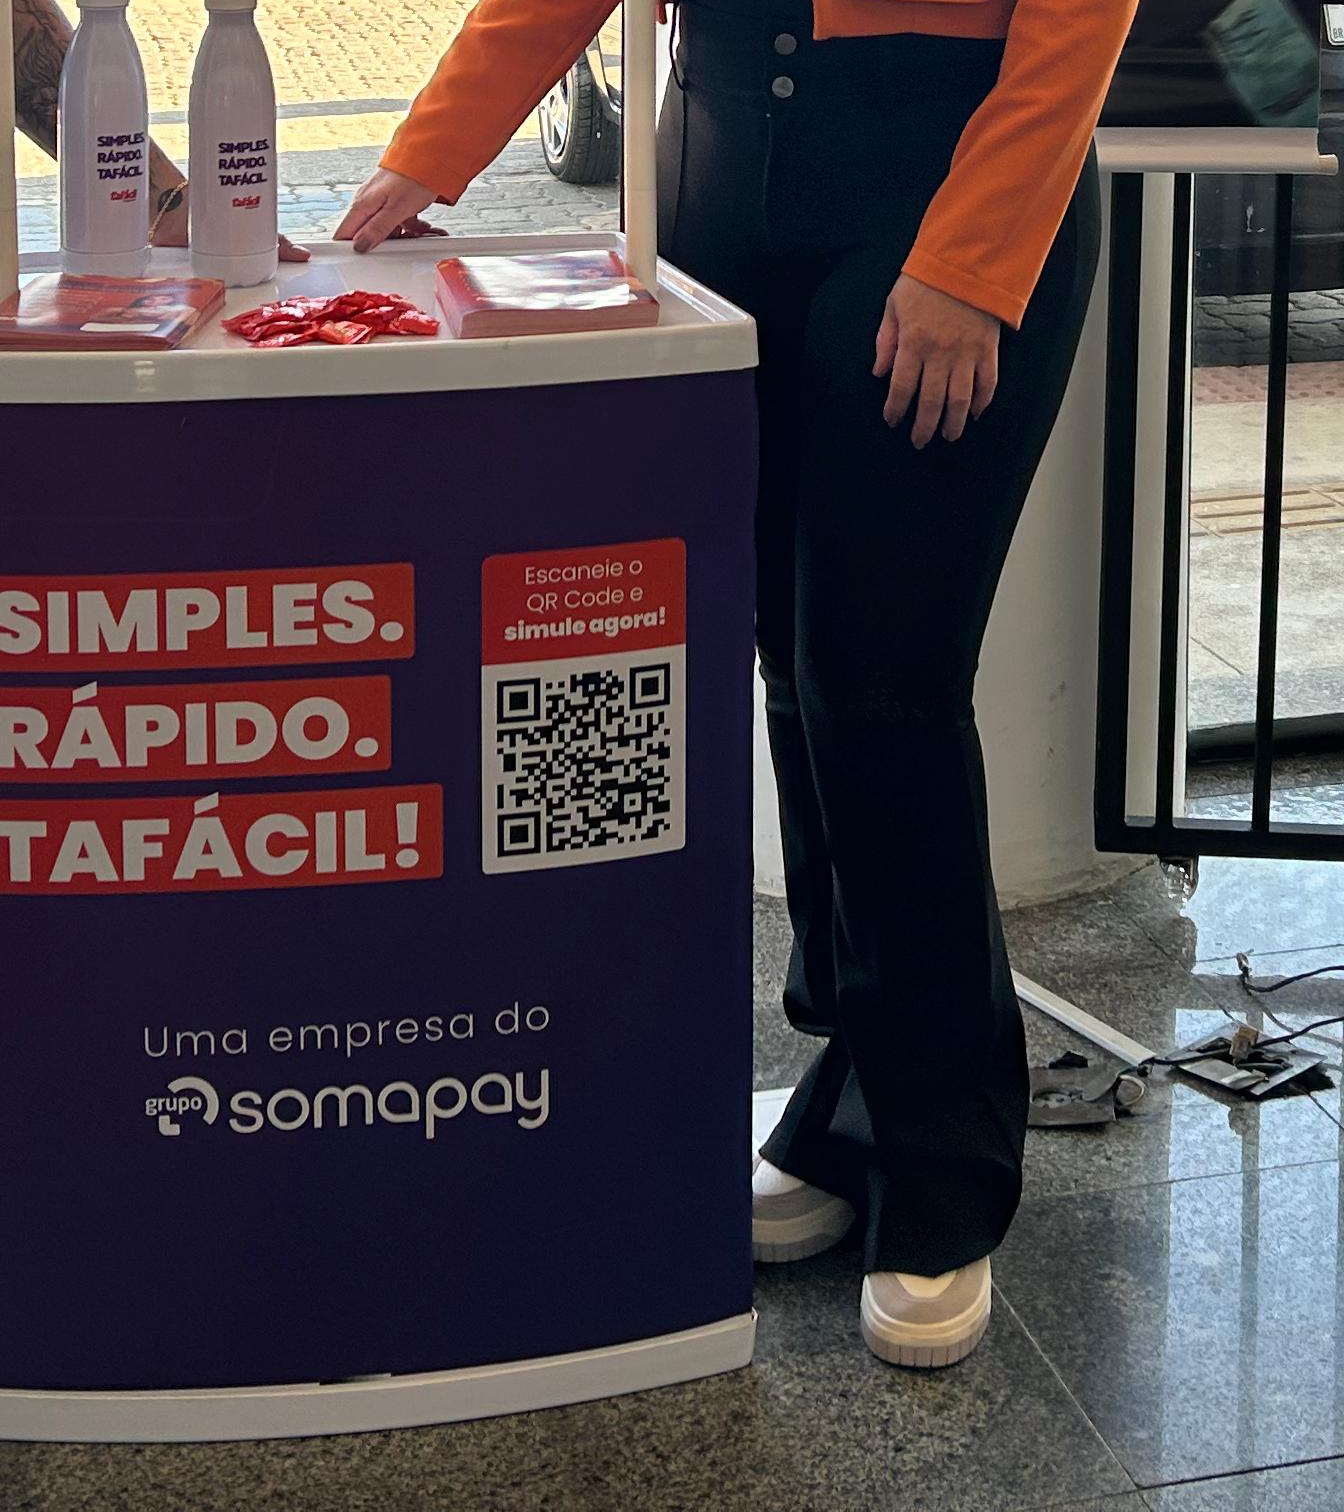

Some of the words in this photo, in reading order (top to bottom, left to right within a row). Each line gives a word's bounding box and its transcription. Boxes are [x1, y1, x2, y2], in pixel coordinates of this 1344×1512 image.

[525, 559, 623, 585] Escaneie
[629, 560, 643, 575] o
[526, 592, 558, 614] QR
[564, 586, 624, 609] Code
[630, 587, 643, 602] e
[504, 617, 586, 641] simule
[589, 606, 666, 638] agora!
[143, 1025, 248, 1057] Uma
[268, 1010, 475, 1058] empresa
[495, 1001, 550, 1034] do
[144, 1094, 202, 1116] grupo
[229, 1068, 550, 1140] somapay
